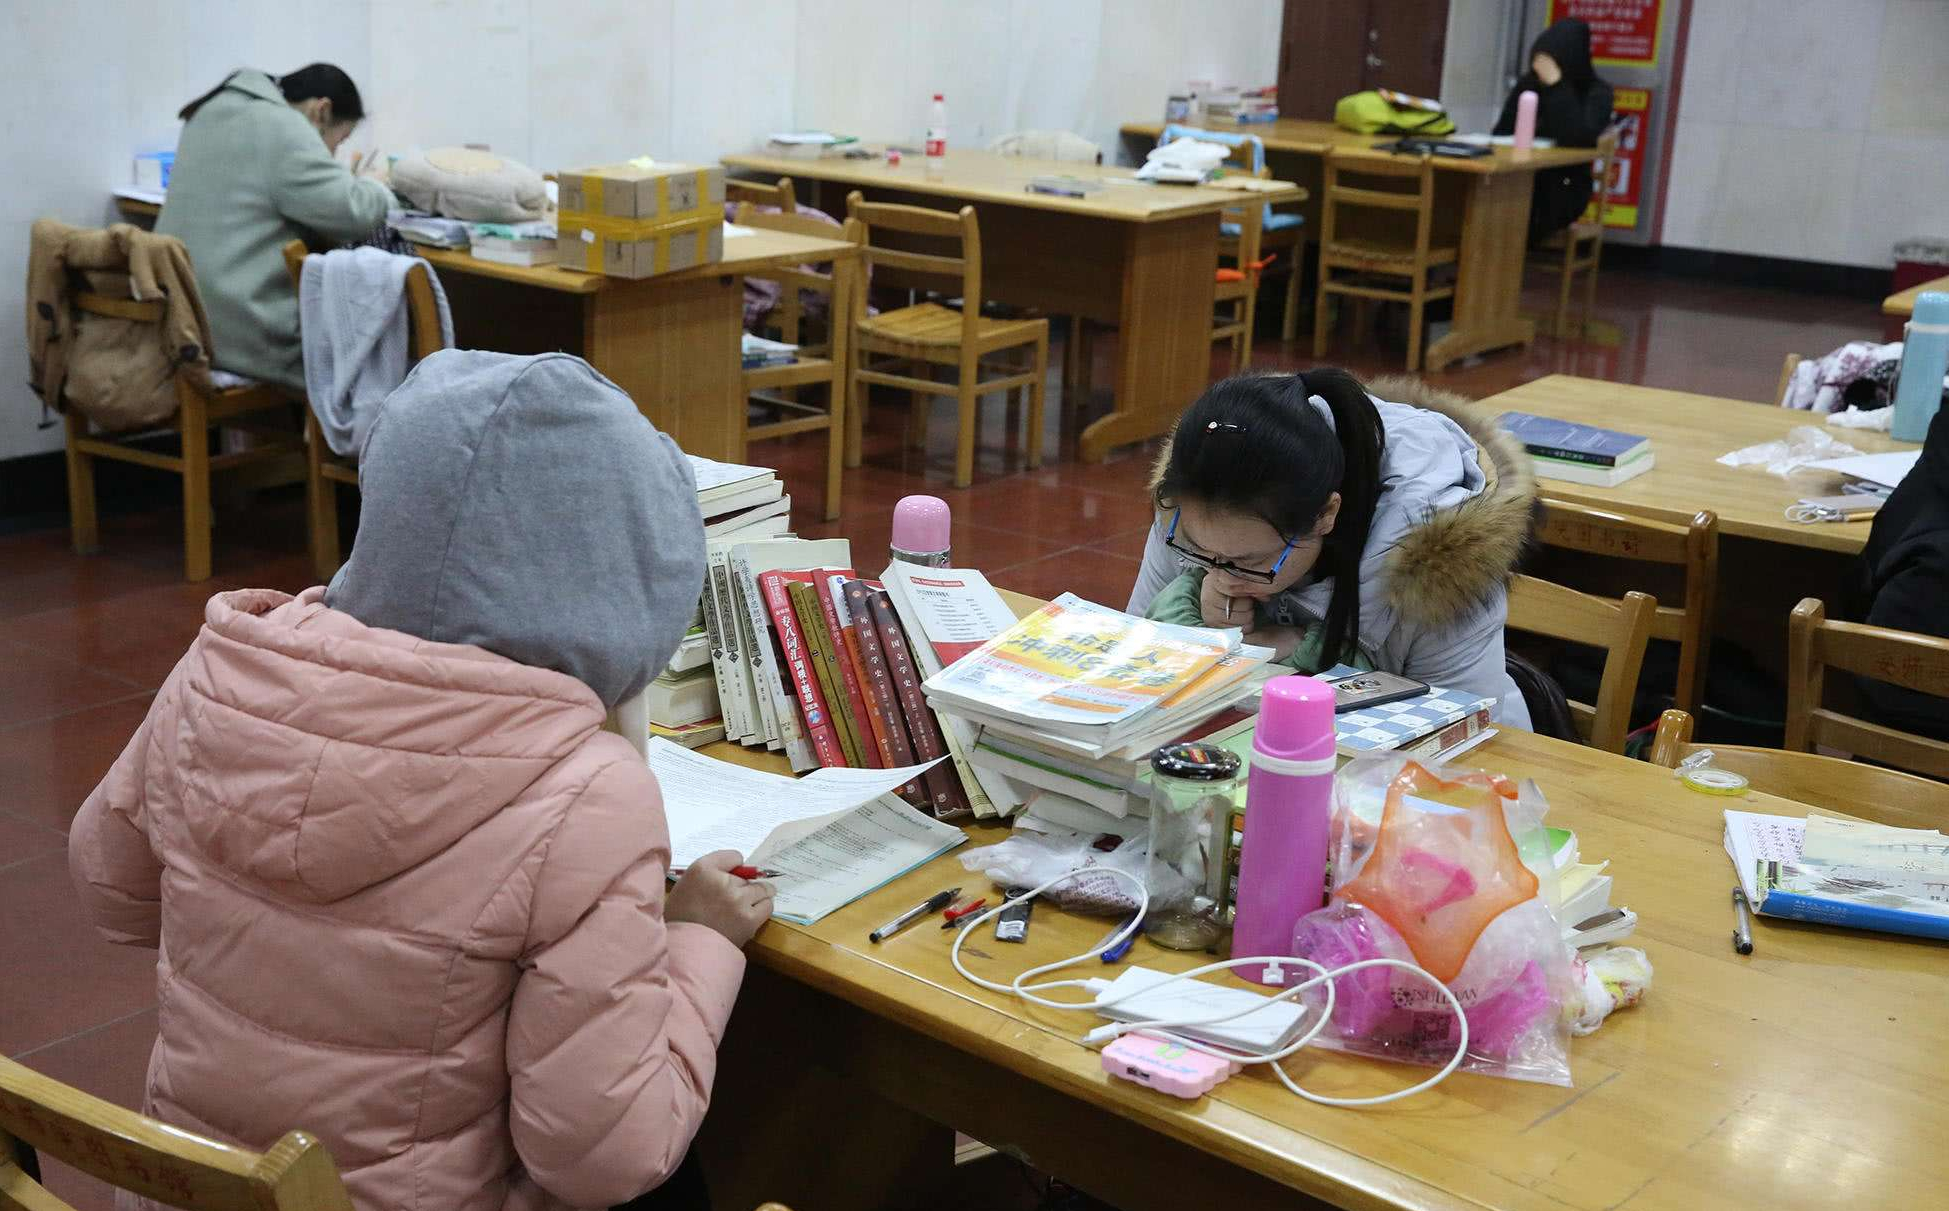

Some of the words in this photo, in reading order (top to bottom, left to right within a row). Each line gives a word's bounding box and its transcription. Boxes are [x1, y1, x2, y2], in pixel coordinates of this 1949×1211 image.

[860, 615, 884, 678] 外国文学史
[886, 626, 912, 688] 外国文学史
